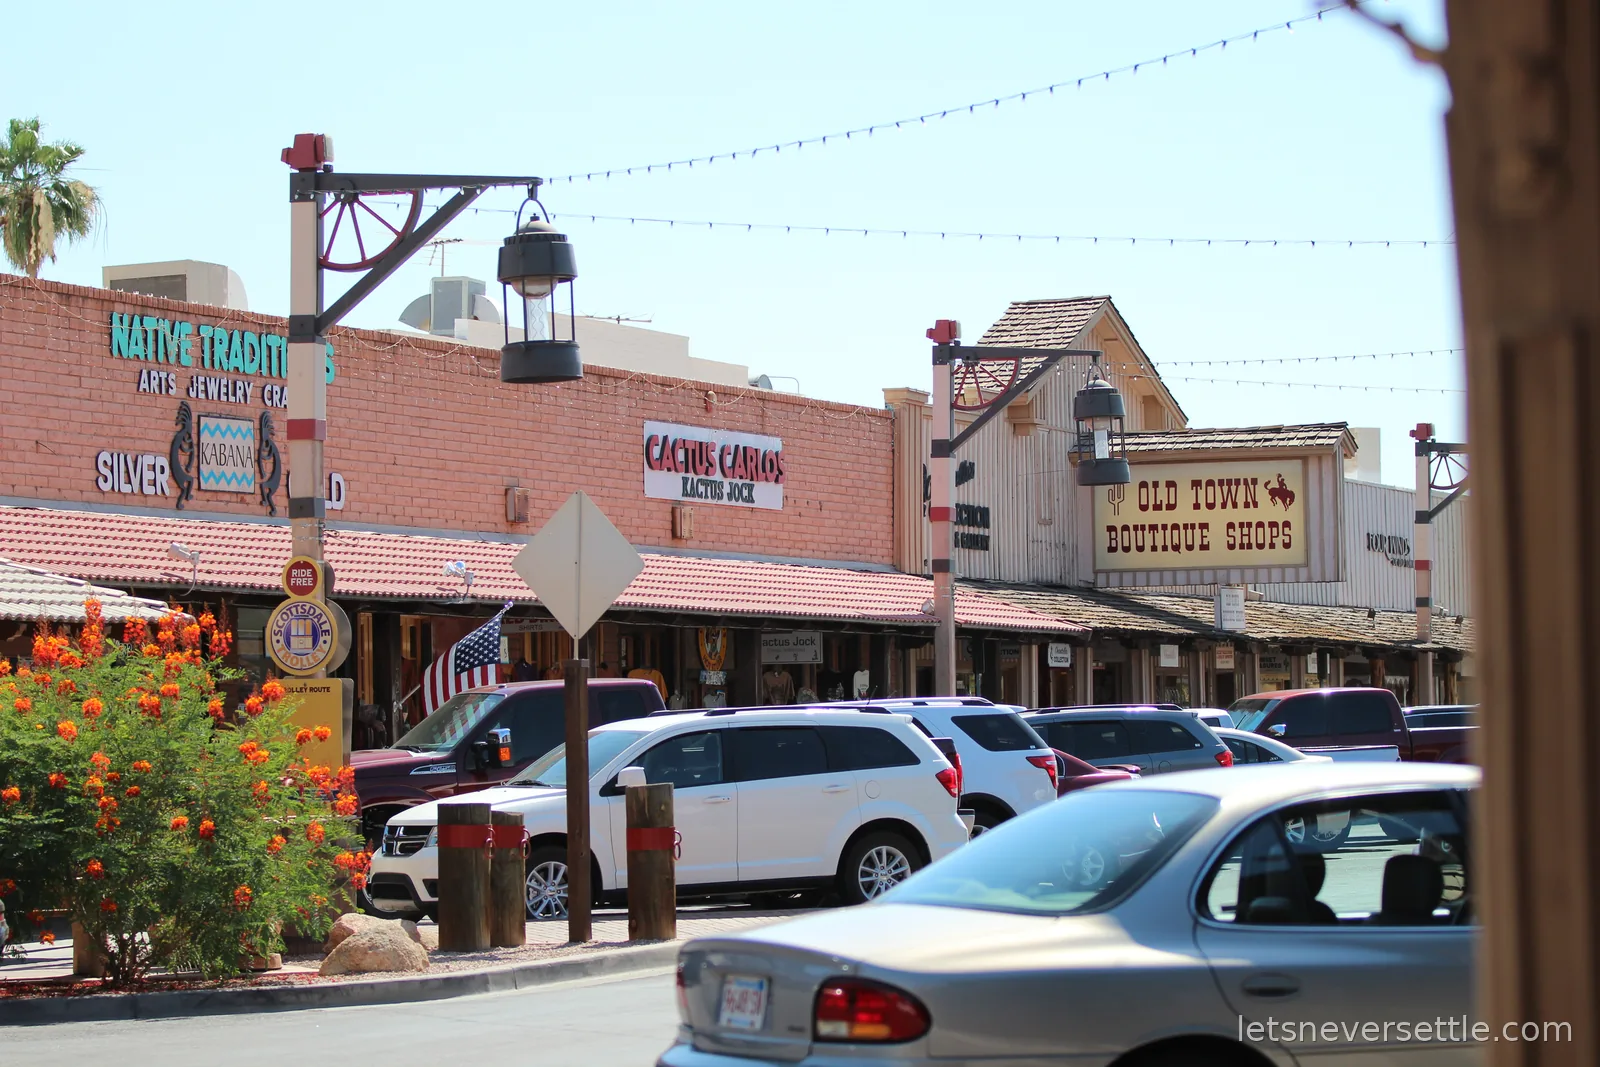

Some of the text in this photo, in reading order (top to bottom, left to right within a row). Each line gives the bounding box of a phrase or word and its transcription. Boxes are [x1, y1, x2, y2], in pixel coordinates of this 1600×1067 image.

[111, 311, 336, 385] NATIVE TRADITIS
[138, 369, 288, 409] ARTS JEWELRY CRA
[200, 442, 254, 469] KABANA
[645, 434, 786, 485] CACTUS CARLOS
[96, 451, 170, 496] SILVER
[681, 476, 755, 504] KACTUS JOCK
[1138, 478, 1259, 512] OLD TOWN
[1106, 520, 1292, 554] BOUTIQUE SHOPS
[290, 578, 313, 586] FREE
[291, 569, 313, 578] RIDE
[273, 603, 330, 636] SCOTTSDALE
[518, 624, 543, 632] SHIRTS
[276, 643, 328, 668] TROLLEY
